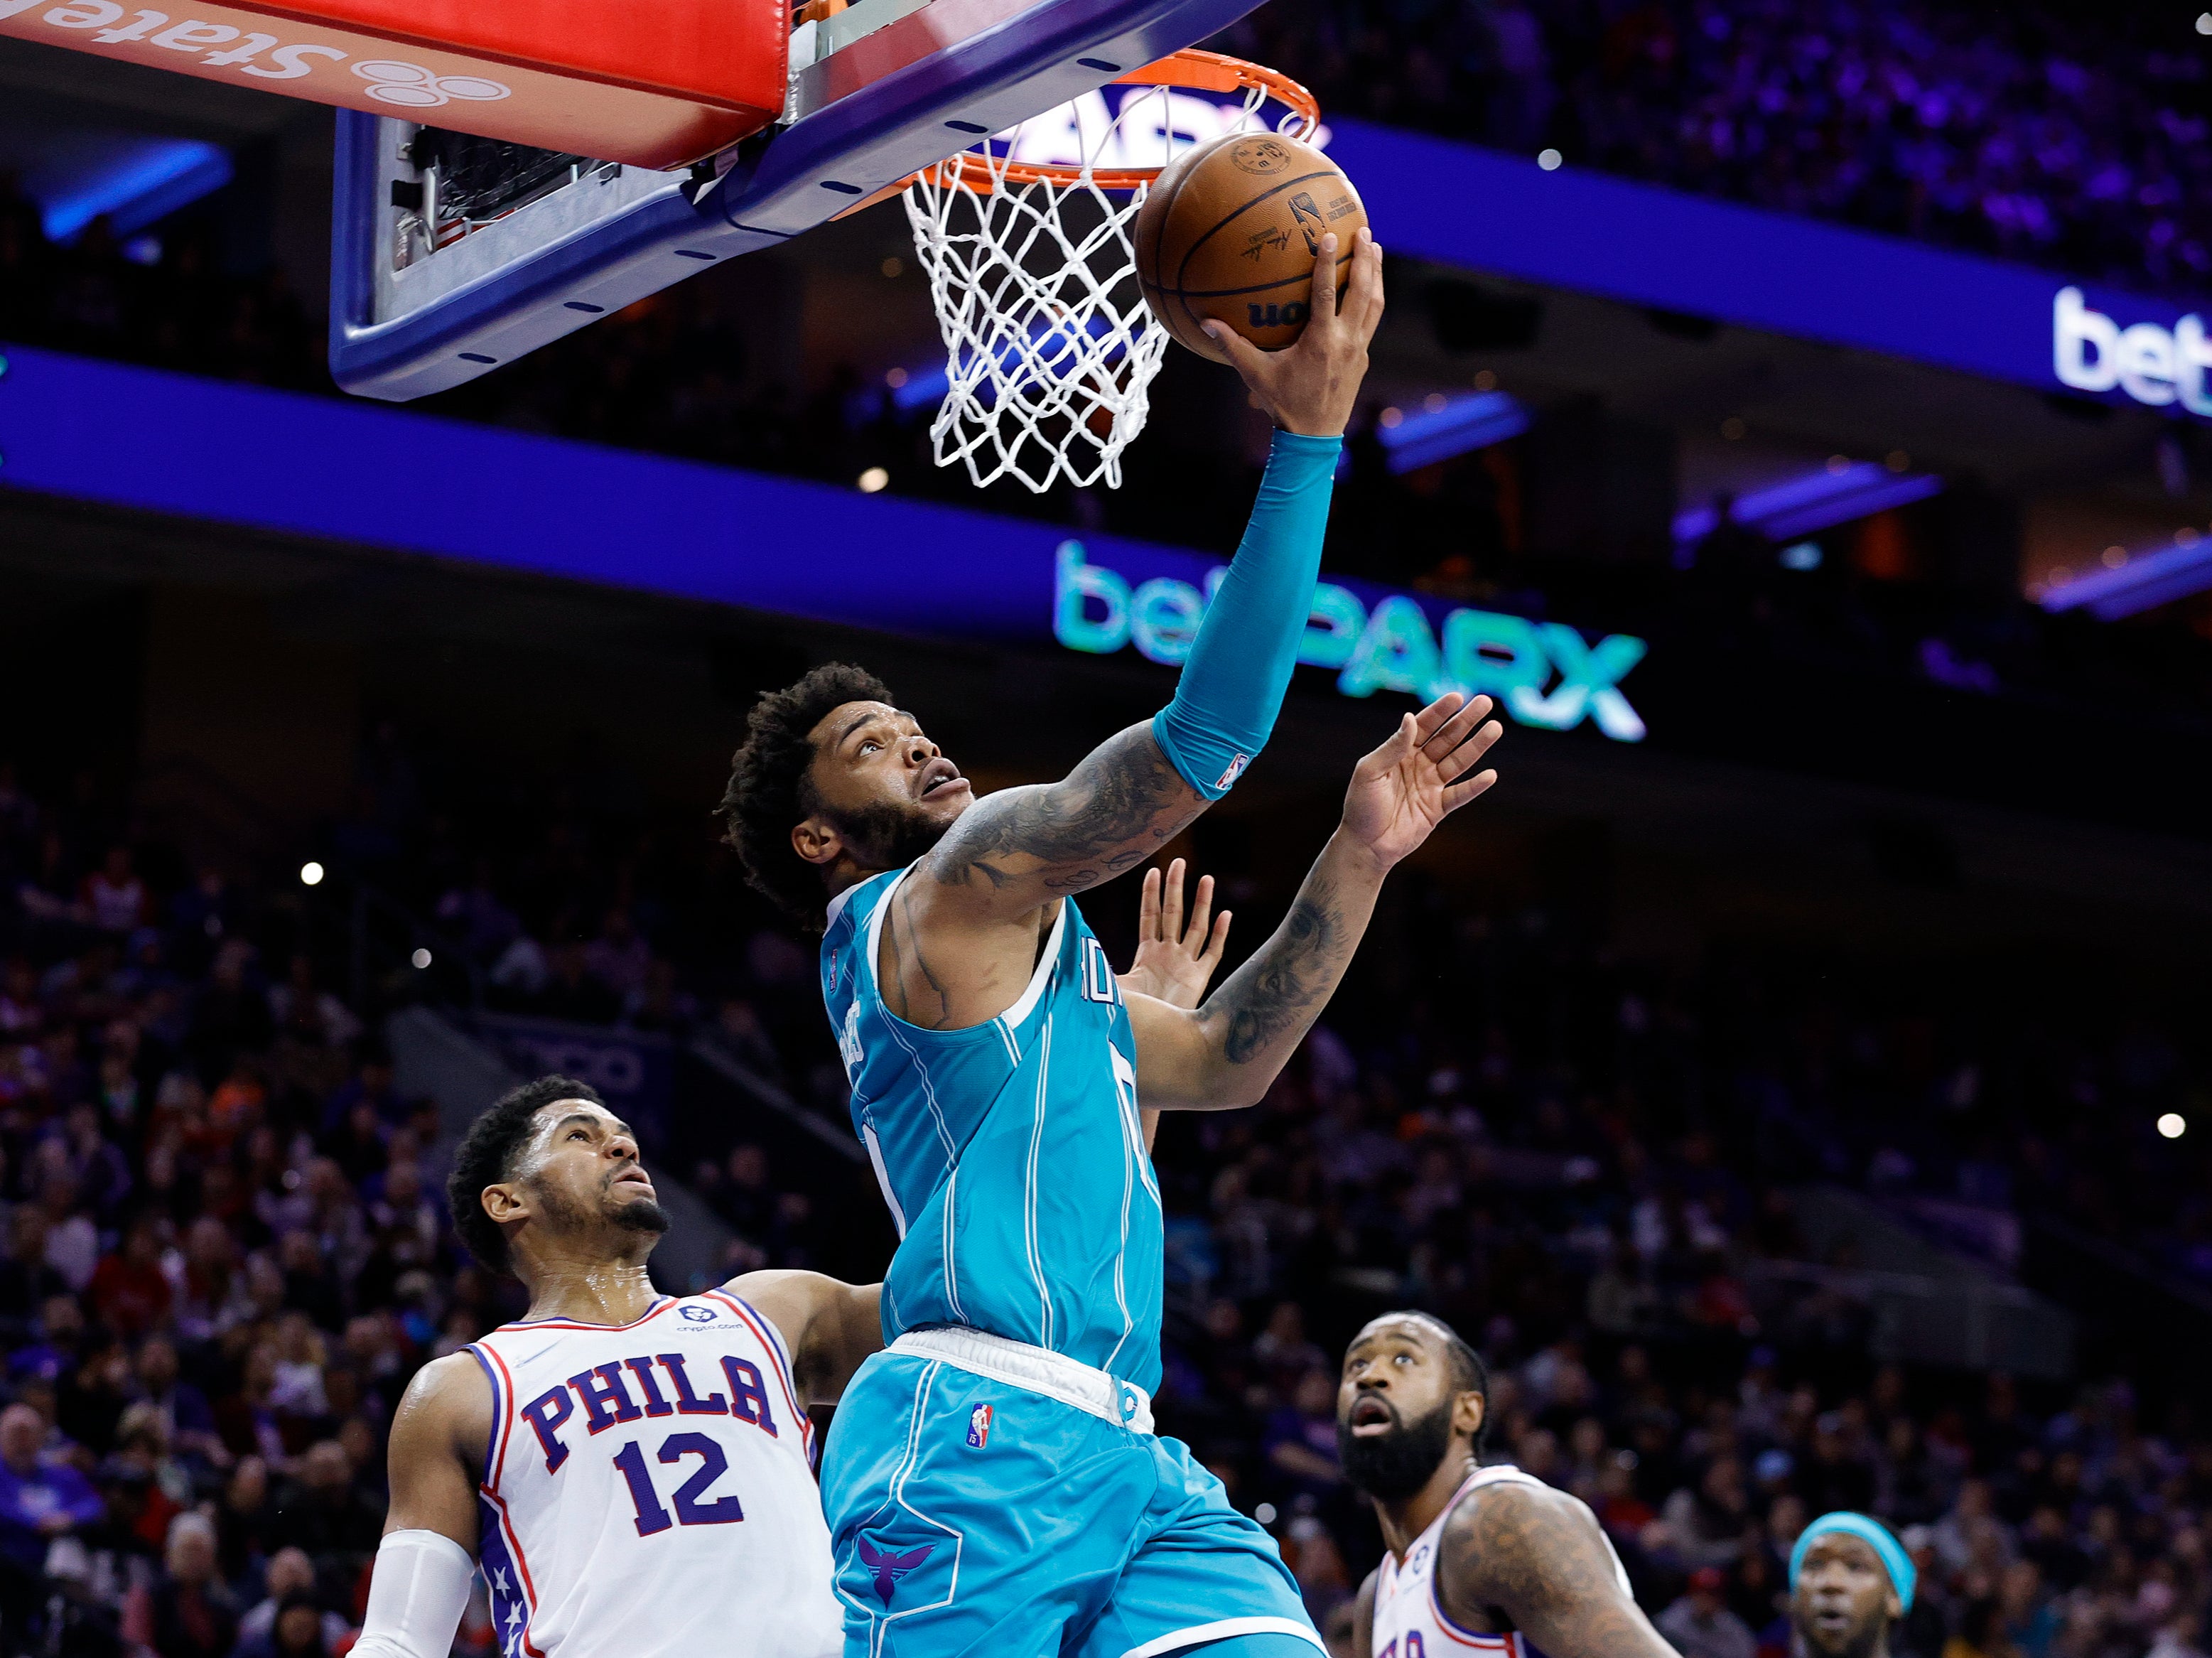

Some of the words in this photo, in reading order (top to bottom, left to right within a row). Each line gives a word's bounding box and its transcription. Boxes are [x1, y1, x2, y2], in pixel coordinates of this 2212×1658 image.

[43, 0, 348, 79] State
[1053, 538, 1649, 743] bePARX
[521, 1353, 778, 1475] PHILA
[613, 1432, 744, 1537] 12
